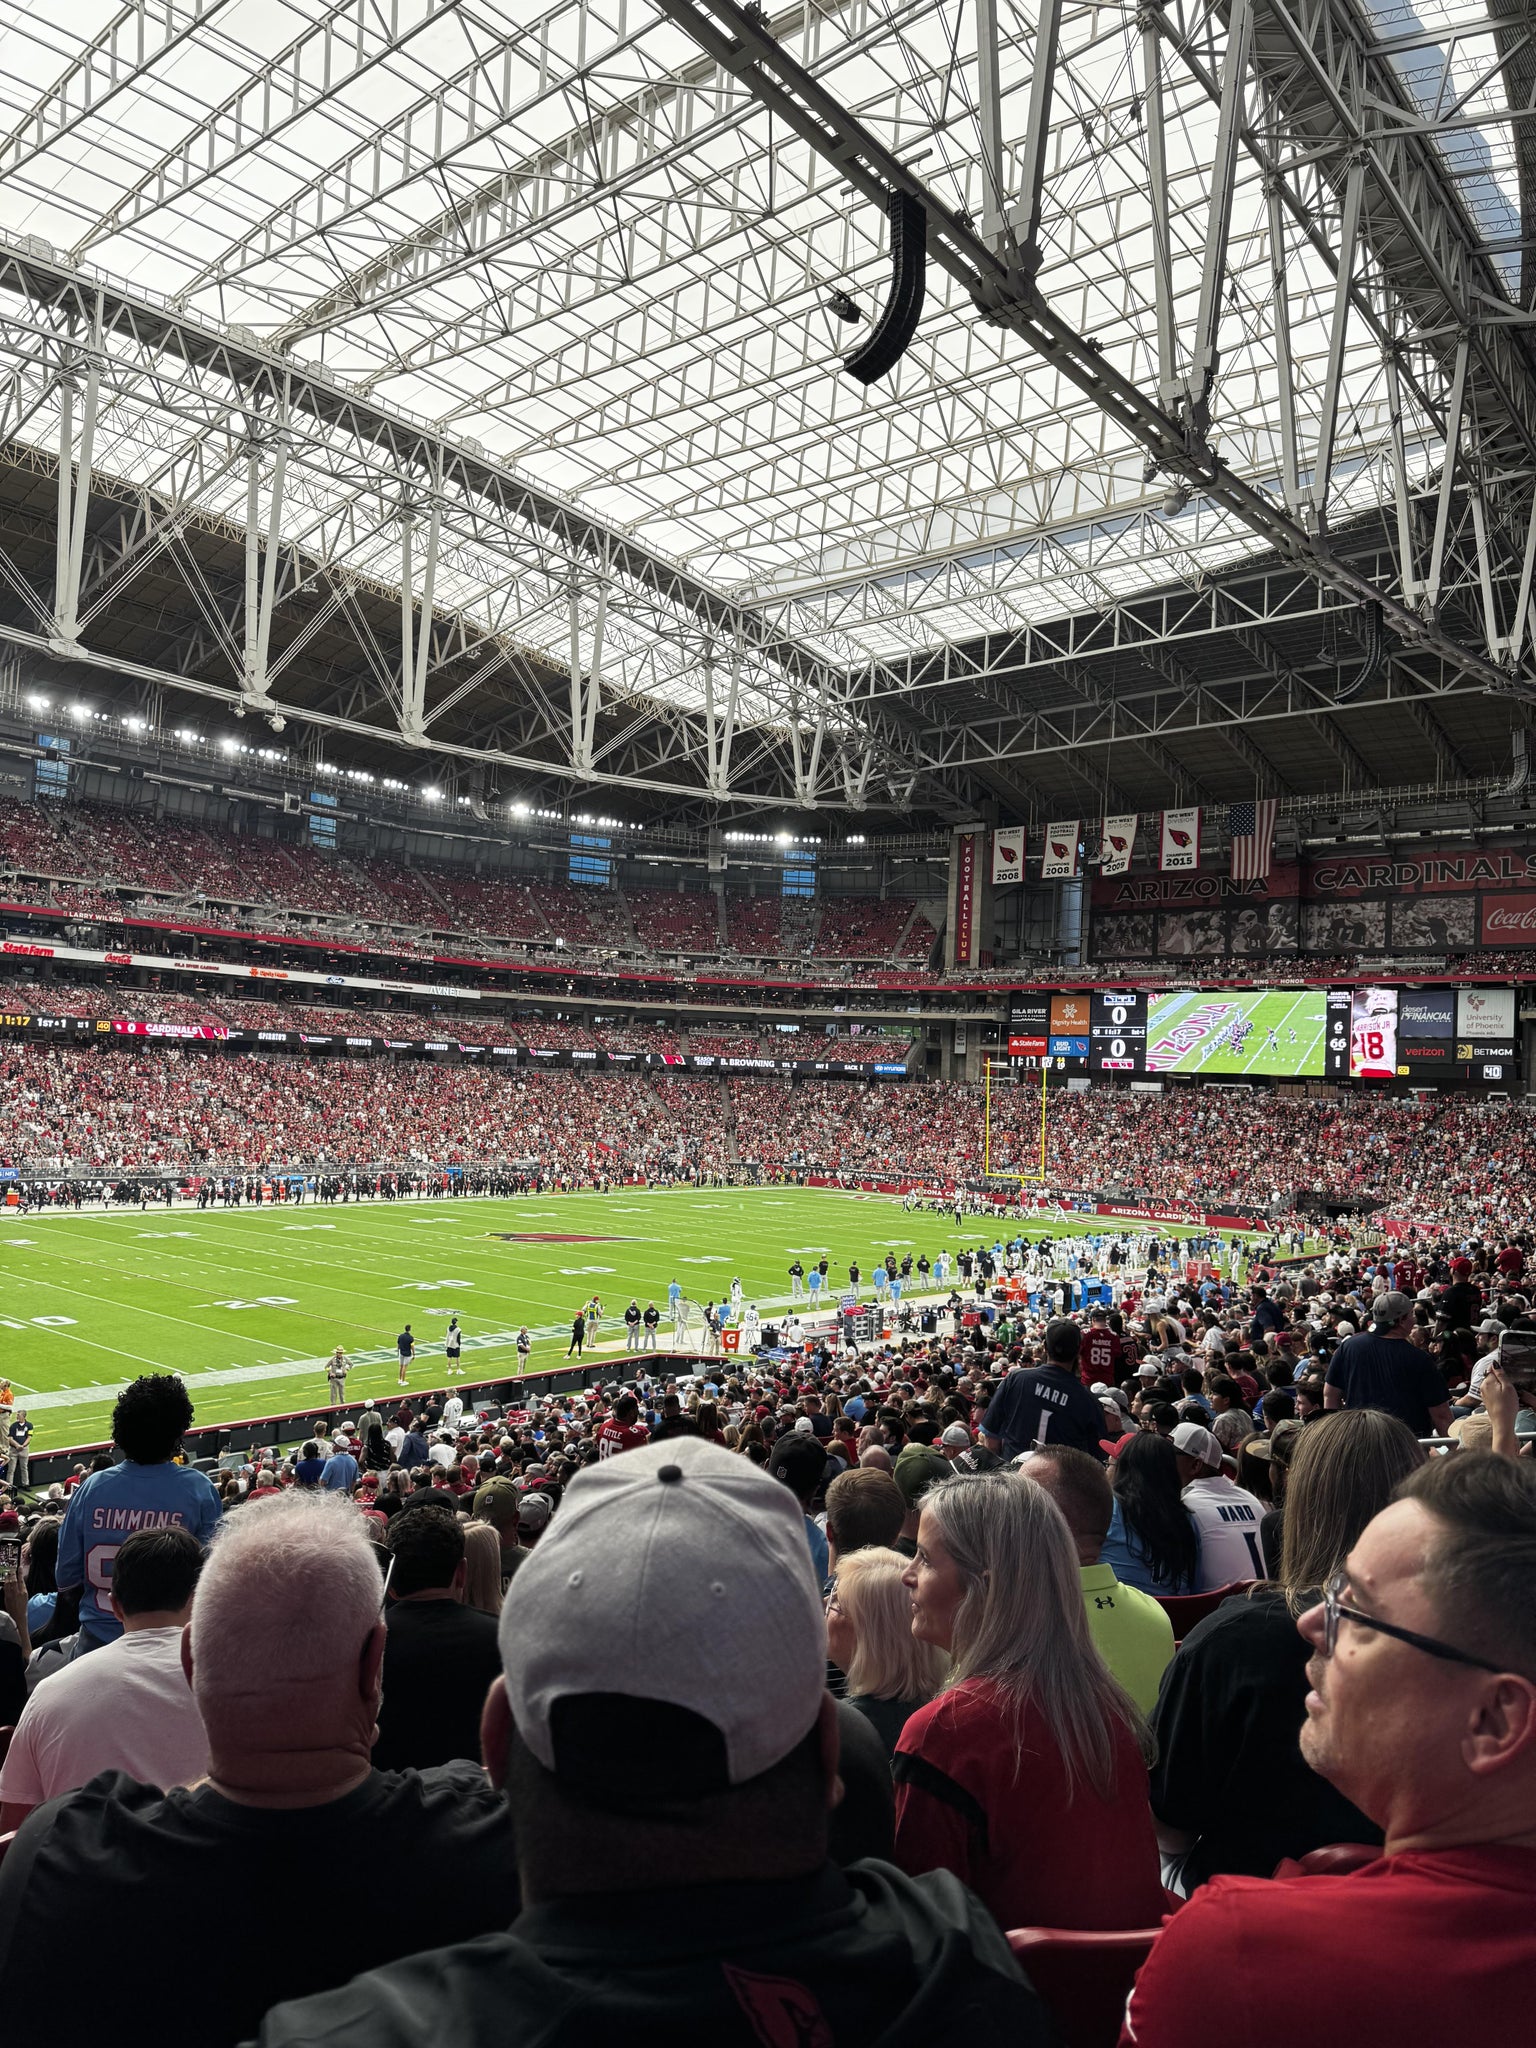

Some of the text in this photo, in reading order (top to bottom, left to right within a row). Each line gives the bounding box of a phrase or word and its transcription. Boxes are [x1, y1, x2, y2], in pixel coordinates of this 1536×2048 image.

[1166, 857, 1192, 866] 2015
[1046, 866, 1070, 875] 2008
[1106, 862, 1126, 872] 2009
[996, 872, 1019, 880] 2008
[962, 847, 971, 920] FOOTBALL
[1114, 876, 1269, 903] ARIZONA
[69, 911, 93, 920] LARRY
[95, 914, 124, 923] WILSON
[1112, 1006, 1127, 1024] 0
[1466, 1014, 1502, 1022] University
[37, 1017, 54, 1028] 1ST
[98, 1022, 109, 1030] 40
[1334, 1021, 1344, 1031] 6
[128, 1022, 198, 1036] 0 CARDINALS
[1110, 1038, 1126, 1058] 0
[1330, 1038, 1347, 1048] 66
[1360, 1032, 1384, 1060] 18
[1405, 1046, 1445, 1056] verizon
[1474, 1048, 1512, 1056] BETMGM
[720, 1058, 728, 1066] B.
[730, 1058, 775, 1068] BROWNING
[1485, 1067, 1500, 1077] 40
[1110, 1207, 1151, 1217] ARIZONA
[1405, 1270, 1411, 1280] 3
[212, 1296, 300, 1310] 20
[726, 1334, 736, 1344] G
[1090, 1347, 1112, 1366] 85
[1034, 1383, 1069, 1406] WARD
[603, 1428, 622, 1440] KITTLE
[1216, 1504, 1255, 1522] WARD
[93, 1508, 182, 1530] SIMMONS
